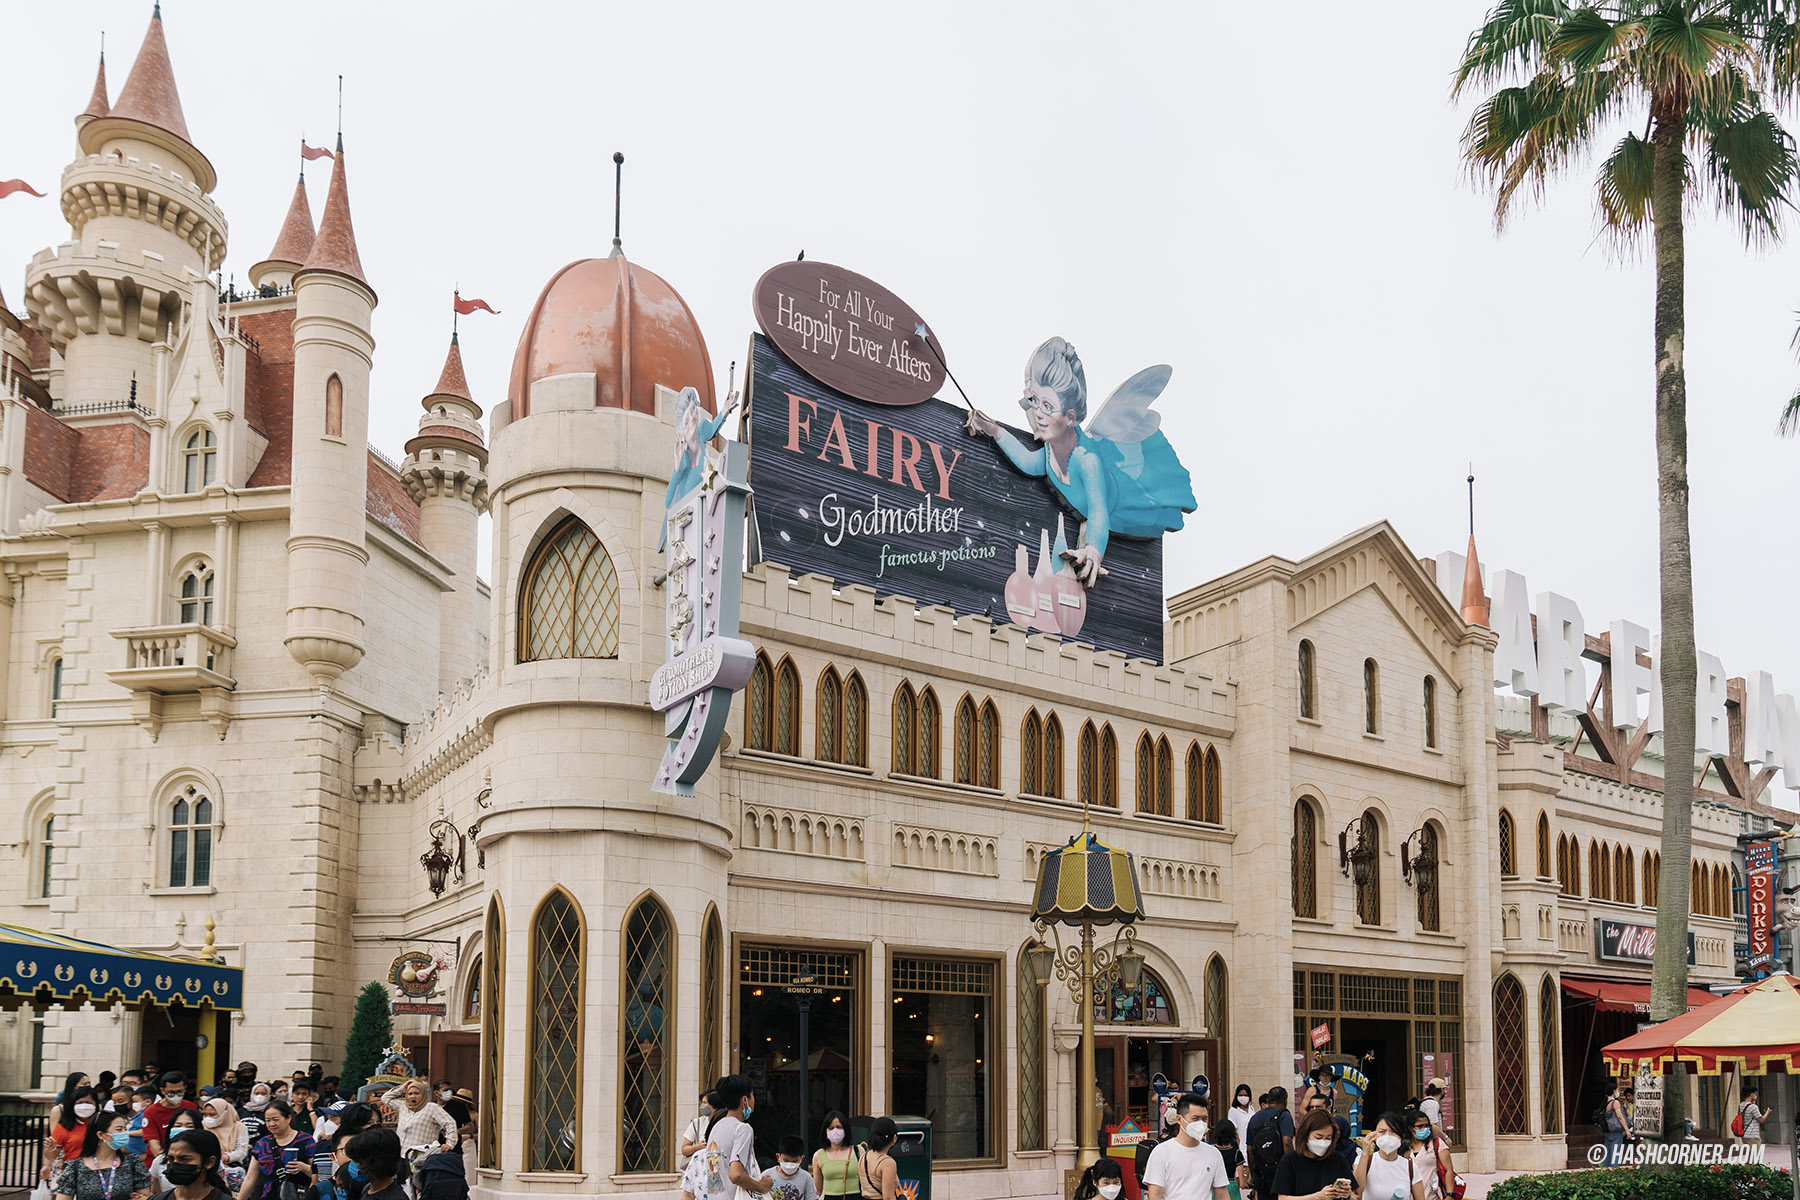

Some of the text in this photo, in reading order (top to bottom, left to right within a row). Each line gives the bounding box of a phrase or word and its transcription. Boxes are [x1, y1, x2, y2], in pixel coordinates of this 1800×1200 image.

[819, 278, 894, 331] For All Your
[776, 292, 931, 383] Happily Ever Afters
[783, 391, 964, 502] FAIRY
[819, 493, 963, 547] Godmother
[668, 505, 696, 657] FAIRY
[876, 543, 996, 578] famous potions
[657, 660, 715, 704] POTION SHOP
[659, 643, 714, 687] GODMOTHER'S
[1610, 618, 1729, 758] FR
[1606, 924, 1620, 938] the
[1342, 1065, 1369, 1091] MAPS
